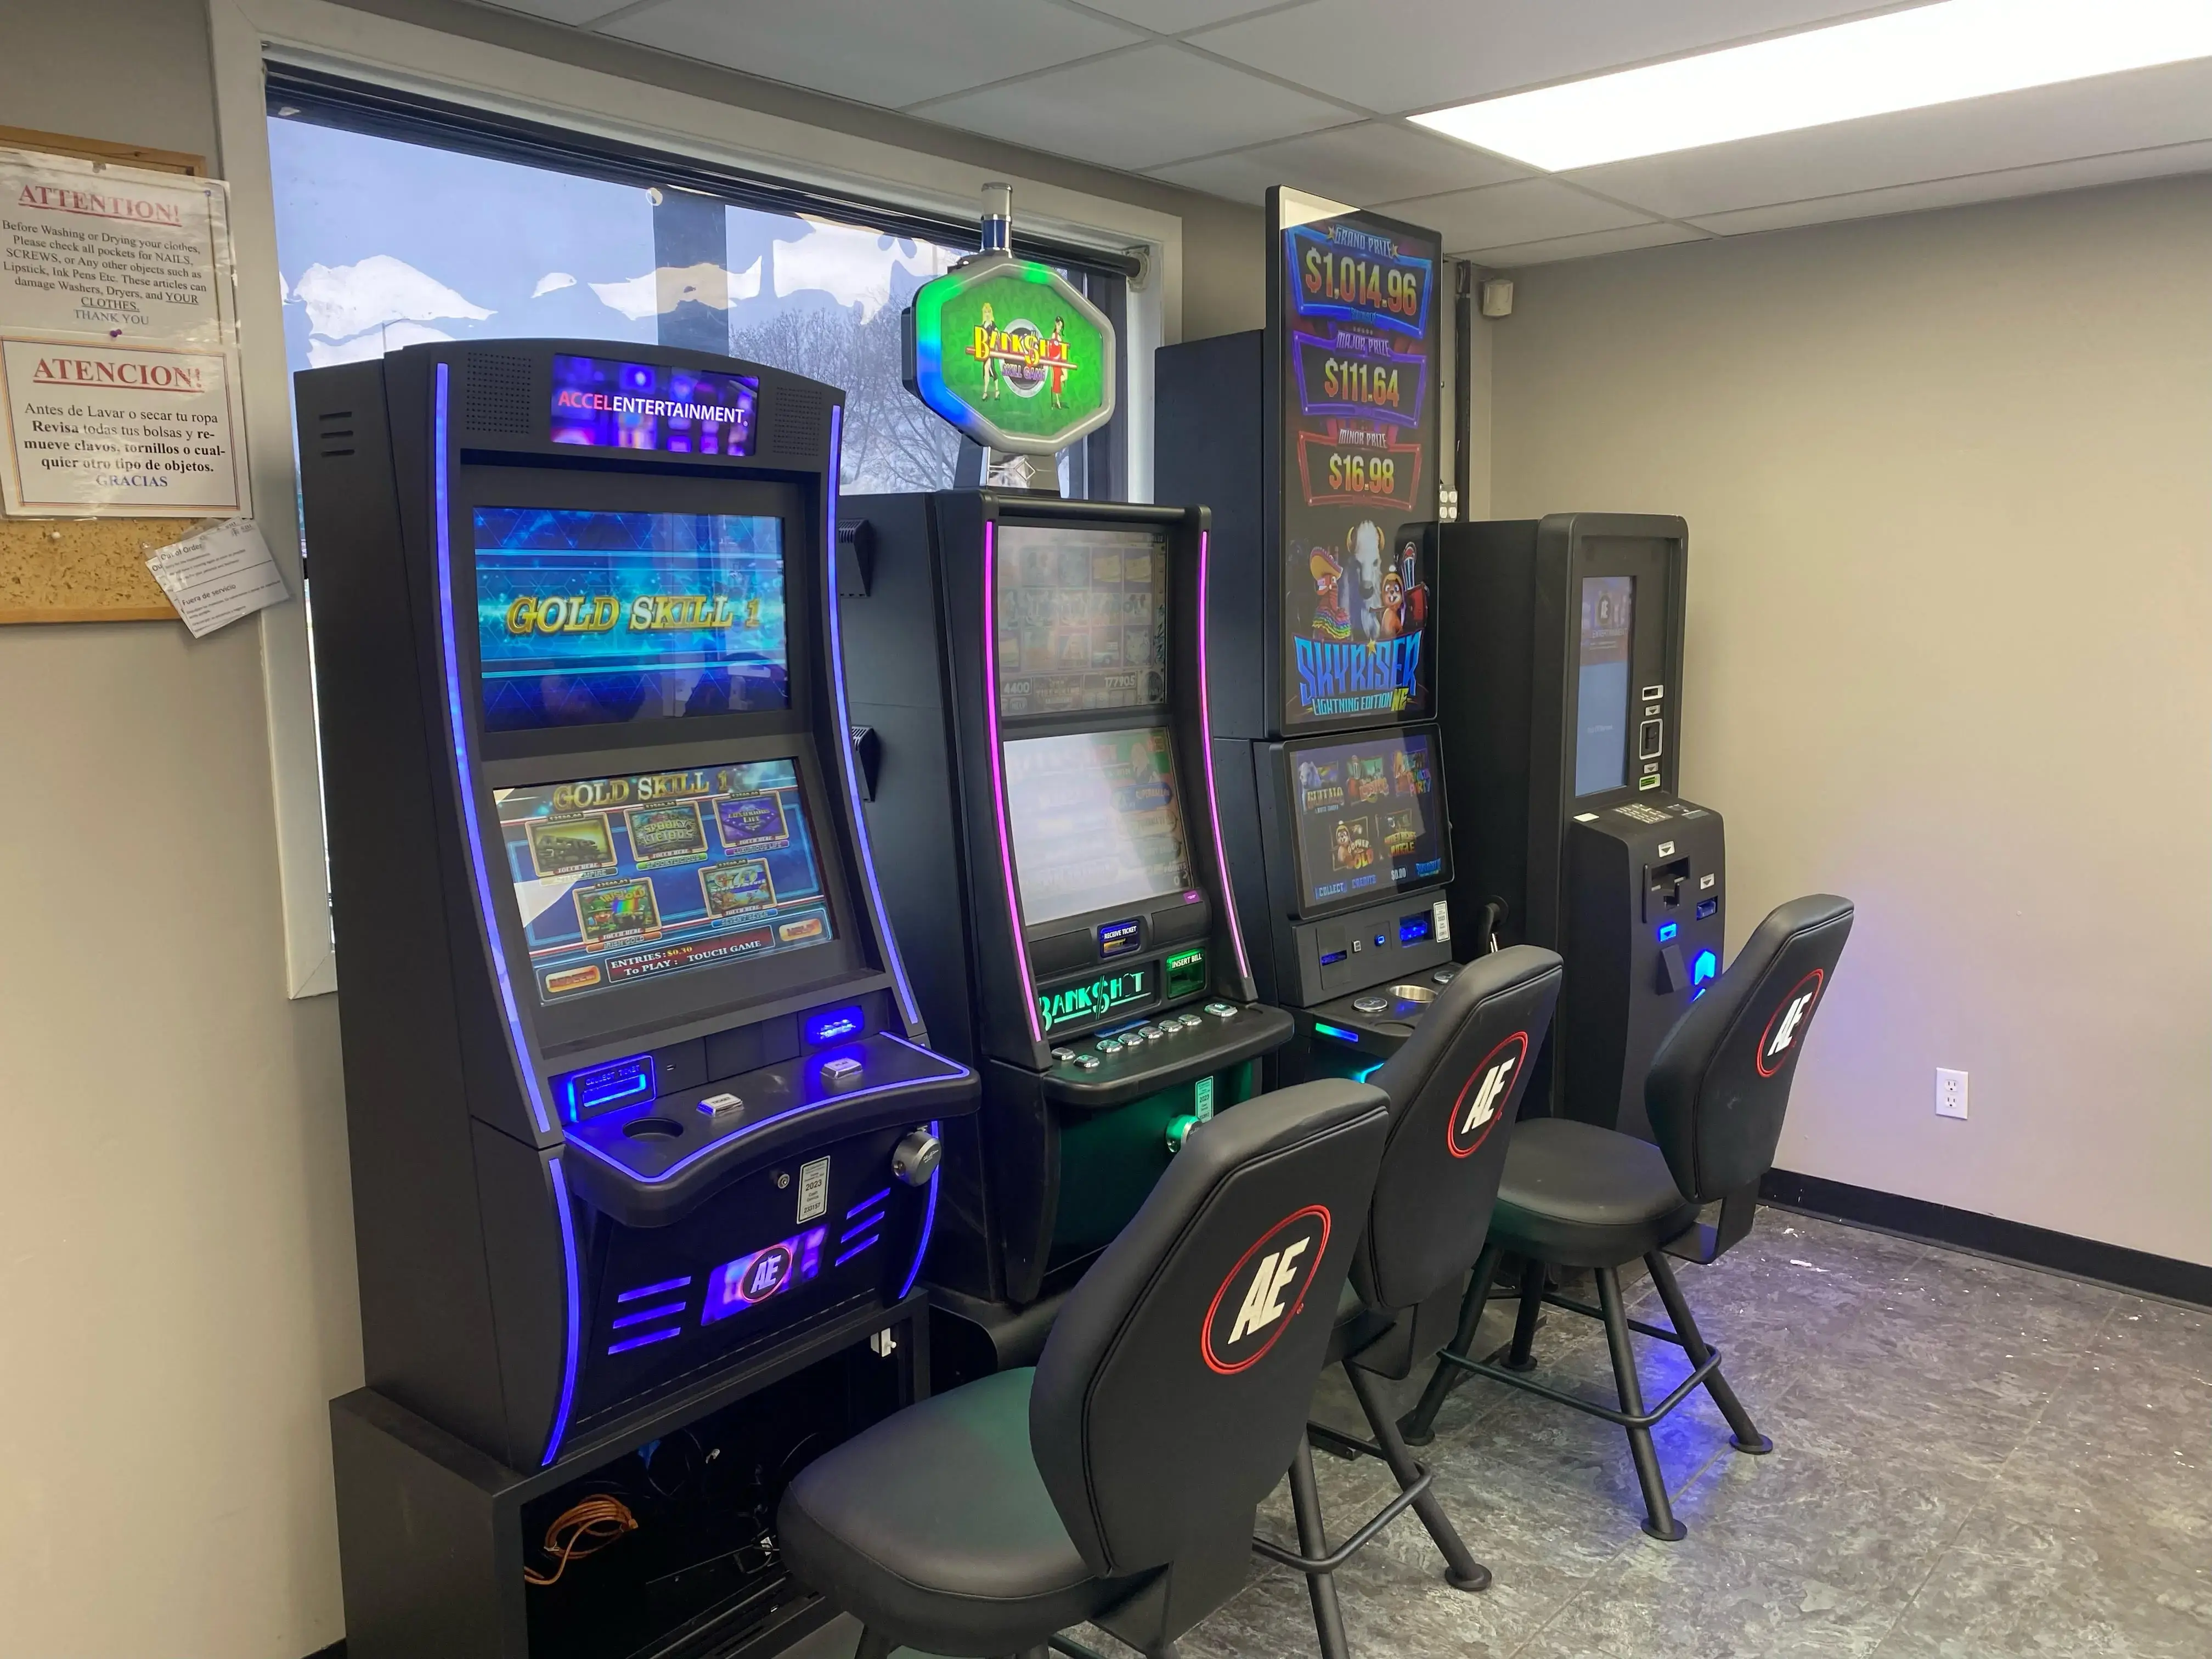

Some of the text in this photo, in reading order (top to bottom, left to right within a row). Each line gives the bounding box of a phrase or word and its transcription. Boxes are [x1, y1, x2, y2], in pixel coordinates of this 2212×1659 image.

[19, 184, 180, 222] ATTENTION!
[2, 219, 38, 233] Before
[41, 224, 85, 241] Washing
[101, 233, 137, 247] Drying
[138, 239, 161, 248] your
[163, 241, 201, 255] clothes,
[13, 235, 194, 266] Please check all pockets for NAILS,
[1334, 224, 1393, 259] GRAND PRIZE
[3, 261, 207, 292] Lipstick, Ink Pens Etc. These articles can
[6, 247, 62, 264] SCREWS,
[77, 256, 99, 269] Any
[101, 260, 128, 270] other
[129, 263, 165, 275] objects
[167, 268, 189, 278] such
[14, 276, 199, 305] damage Washers, Dryers, and YOUR
[1305, 246, 1417, 316] $1,014.96
[73, 309, 149, 325] THANK YOU
[1336, 331, 1391, 358] MAJOR PRIZE
[33, 357, 201, 389] ATENCION!
[1001, 363, 1046, 382] SKILL GAME
[1324, 357, 1400, 407] $111.64
[24, 402, 218, 425] Antes de Lavar o secar tu ropa
[32, 420, 215, 441] Revisa todas tus bolsas y re-
[1338, 428, 1387, 449] MINOR PRIZE
[24, 439, 70, 450] mueve
[125, 443, 179, 455] tornillos
[183, 446, 191, 455] o
[194, 445, 225, 456] cual-
[41, 456, 214, 474] quier otro tipo de objetos.
[1329, 453, 1394, 494] $16.98
[95, 475, 168, 487] GRACIAS
[183, 543, 202, 554] Order
[152, 563, 162, 572] Ou
[182, 596, 201, 606] Fuera
[211, 583, 236, 596] servicio
[506, 595, 761, 635] GOLD SKILL 1
[1294, 630, 1423, 707] SKYRISER
[1003, 675, 1136, 693] 4400 177905
[1311, 697, 1359, 716] LIGHTNING
[1361, 691, 1393, 711] EDITION
[552, 770, 730, 811] GOLD SKILL 1
[646, 854, 701, 868] SPOOKYLICIOUS
[1319, 882, 1344, 897] COLLECT
[1391, 867, 1406, 881] $0.00
[604, 936, 645, 949] IRISH GOLD
[1104, 926, 1137, 940] RECEIVE TICKET
[623, 940, 761, 976] To PLAY TOUCH GAME
[1171, 952, 1203, 969] INSERT BILL
[1767, 992, 1813, 1057] AE
[1461, 1057, 1516, 1135] AE
[805, 1179, 822, 1191] 2023
[803, 1202, 821, 1214] 233157
[750, 1254, 782, 1294] AE
[1227, 1237, 1310, 1345] AE
